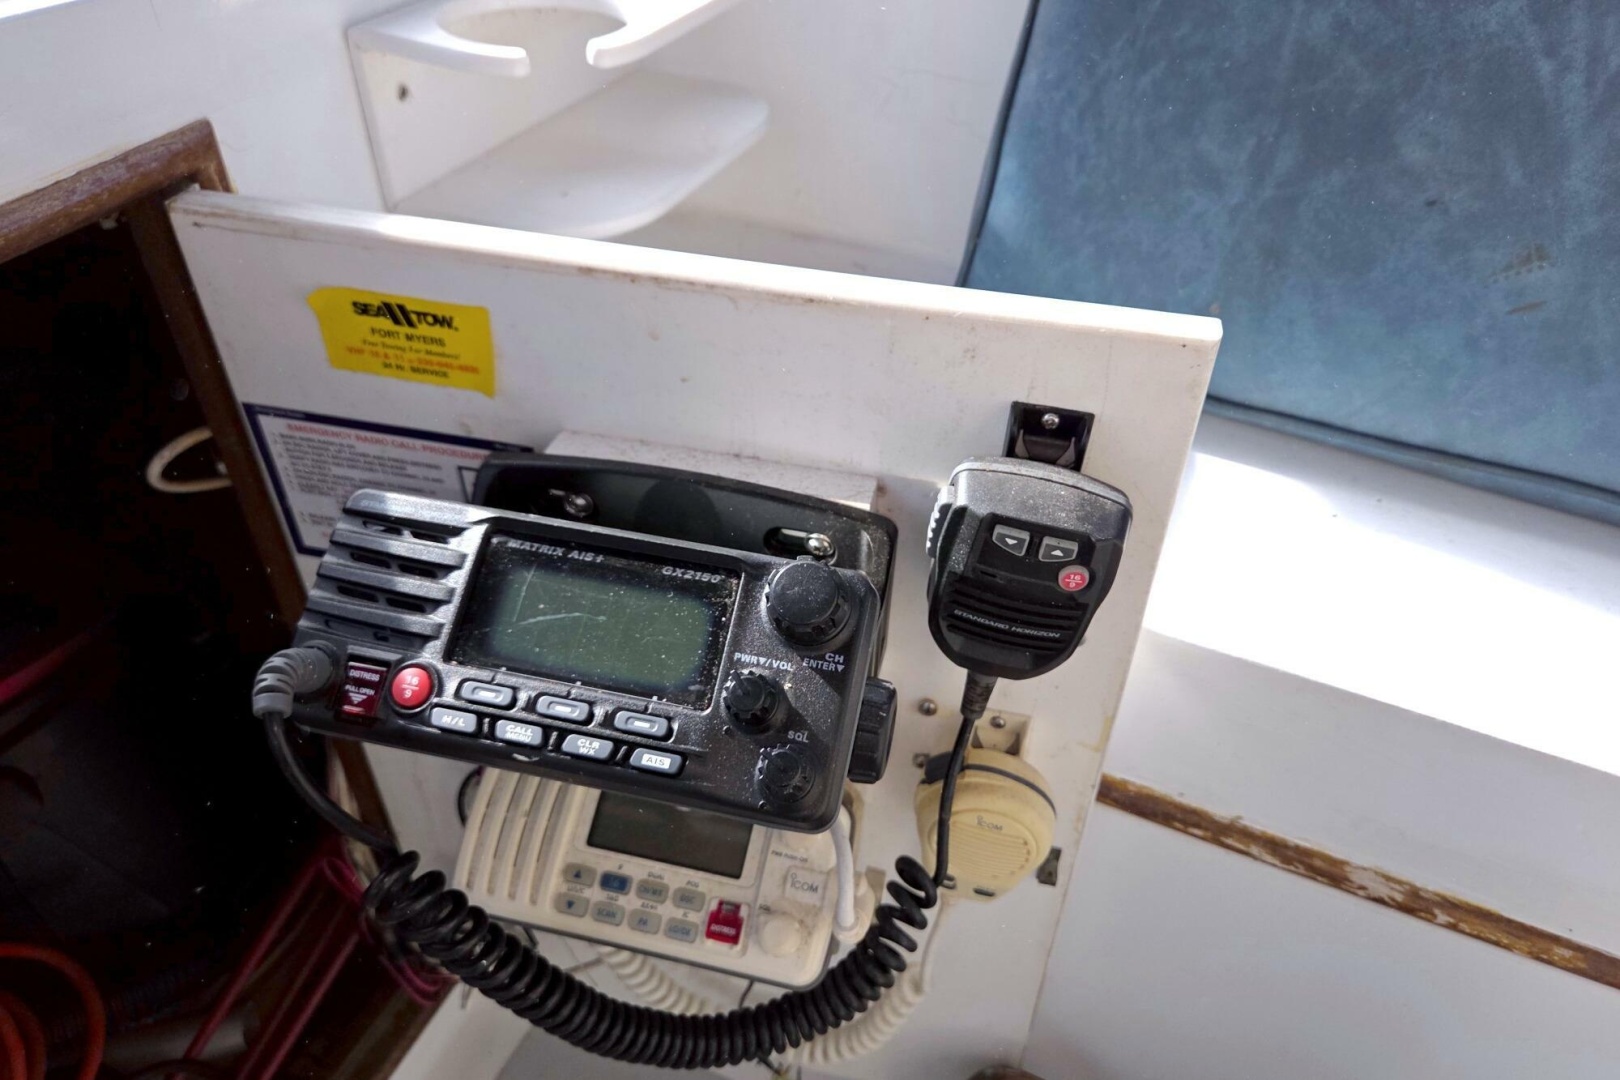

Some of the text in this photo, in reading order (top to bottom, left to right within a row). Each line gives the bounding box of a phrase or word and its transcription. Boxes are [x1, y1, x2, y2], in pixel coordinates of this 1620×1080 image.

[352, 301, 390, 319] SEA
[370, 327, 447, 347] FORT MYERS
[410, 365, 450, 378] SERVICE
[286, 423, 352, 440] EMERGENCY
[355, 434, 390, 447] RADIO
[391, 439, 417, 450] CALL
[508, 540, 604, 563] MATRIX AIS+
[1070, 573, 1081, 581] 16
[954, 608, 1061, 639] STANDARD HORIZON
[803, 657, 836, 671] ENTER
[825, 652, 844, 663] CH
[348, 669, 381, 682] DISTRESS
[405, 675, 420, 686] 16
[345, 684, 376, 696] PULL OPEN
[404, 689, 412, 698] 9
[442, 714, 466, 727] H/L
[505, 724, 534, 736] CALL
[787, 730, 810, 743] SQL
[505, 731, 532, 743] MENU
[577, 738, 600, 749] CLR
[579, 746, 597, 756] WX
[645, 756, 666, 767] AIS
[790, 872, 819, 893] ICOM
